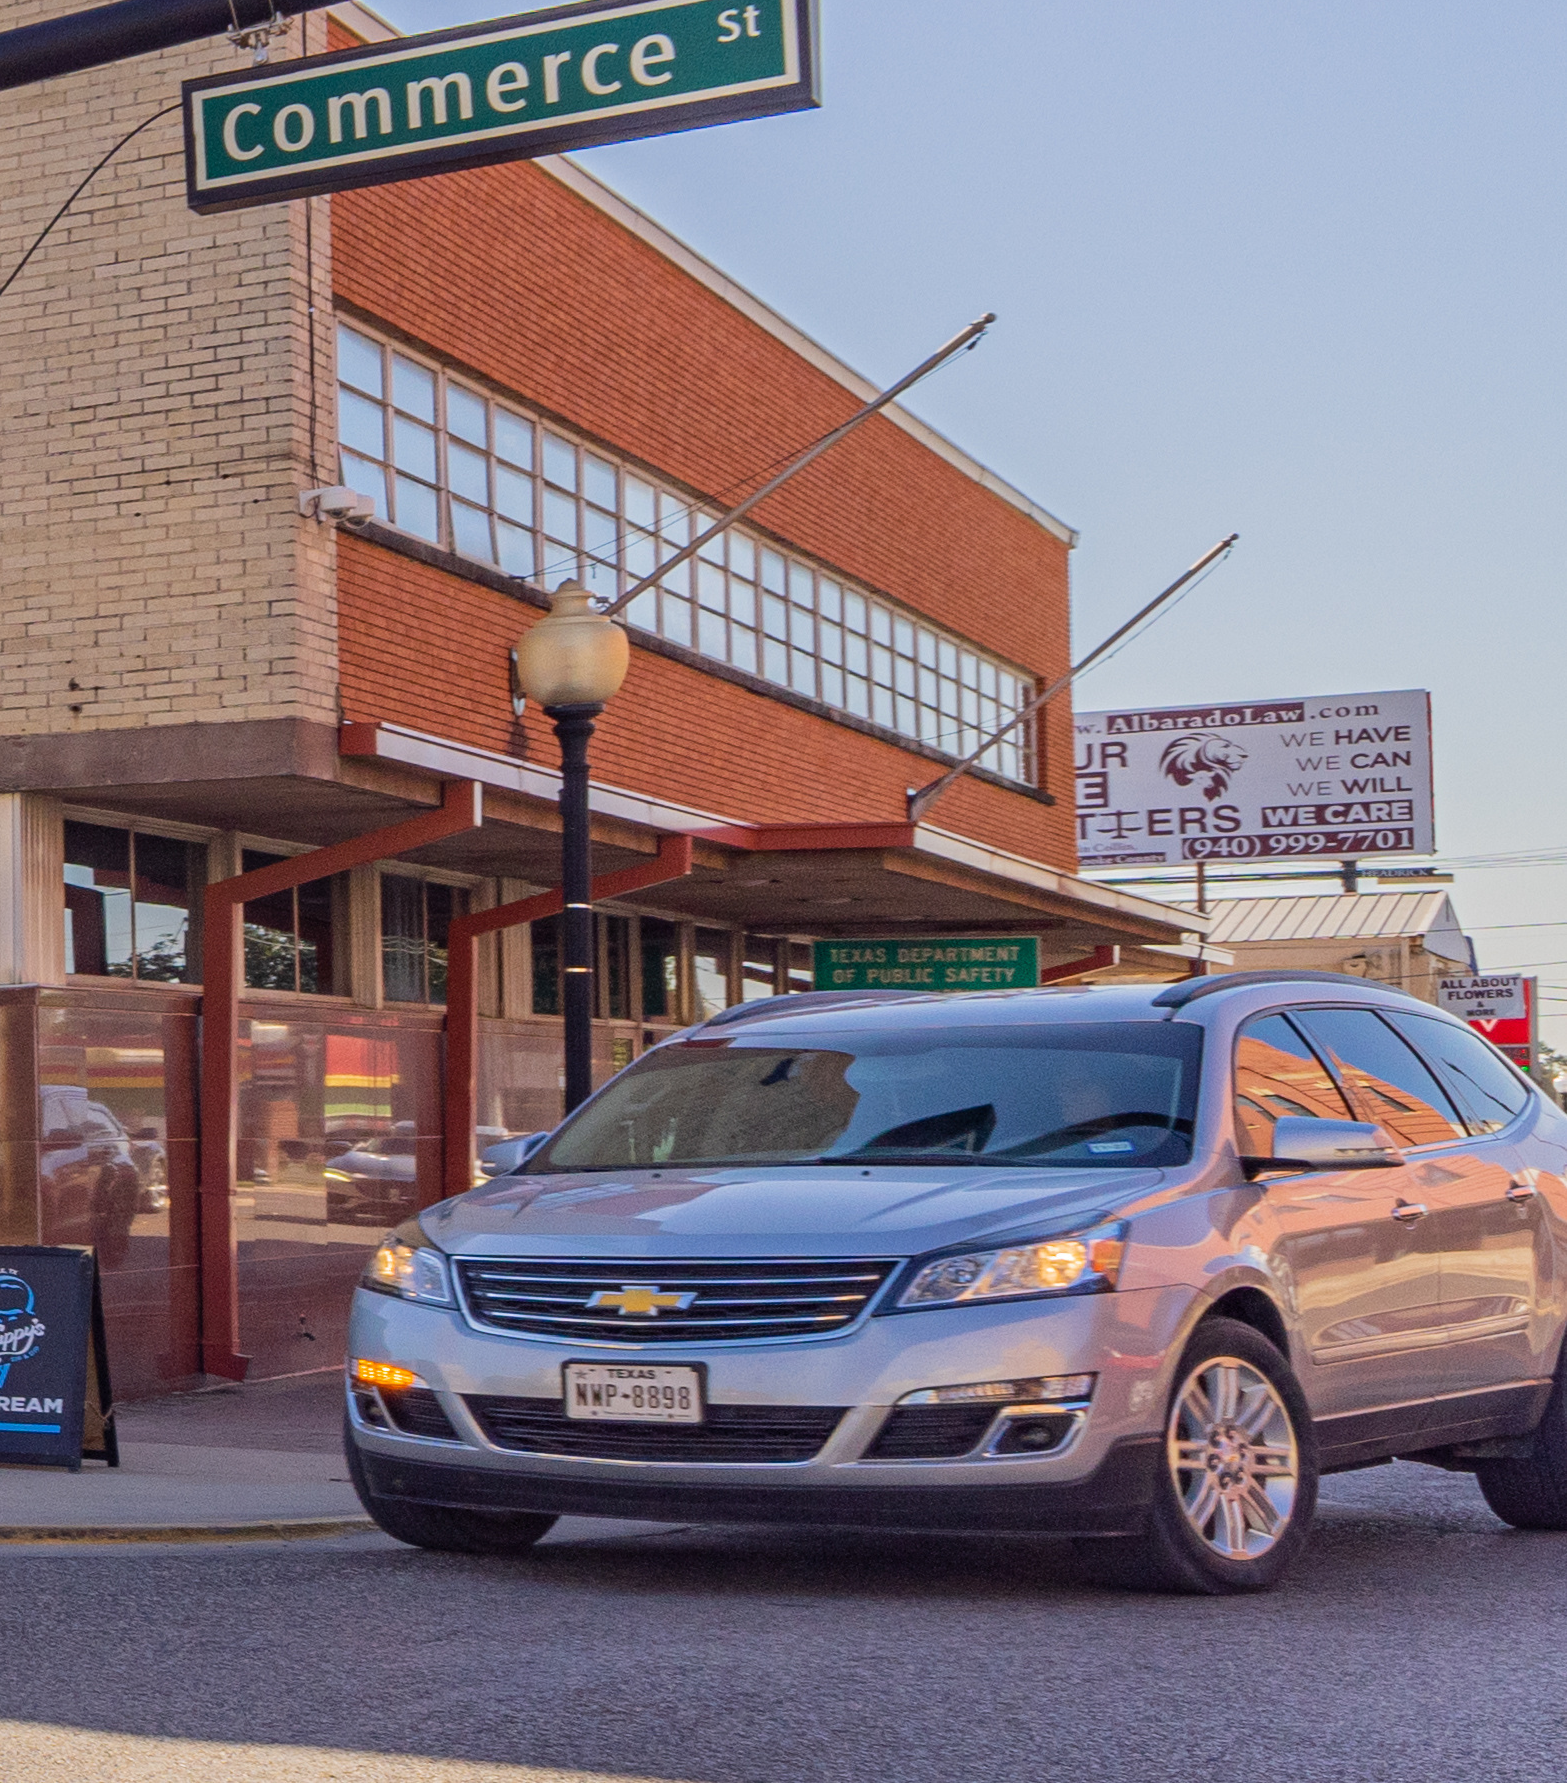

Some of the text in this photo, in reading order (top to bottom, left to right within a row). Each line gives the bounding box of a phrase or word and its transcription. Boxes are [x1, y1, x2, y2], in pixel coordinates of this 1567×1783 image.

[221, 4, 762, 161] Commerce St
[1280, 725, 1412, 748] WE HAVE
[1296, 750, 1412, 771] WE CAN
[1287, 776, 1413, 797] WE WILL
[1264, 801, 1411, 826] WE CARE
[1183, 829, 1412, 860] (940) 999-7701
[830, 946, 1020, 963] TEXAS DEPARTMENT
[833, 967, 1016, 984] OF PUBLIC SAFETY
[1440, 977, 1519, 990] ALL ABOUT
[1447, 989, 1514, 1001] FLOWERS
[1466, 1008, 1496, 1017] MORE
[607, 1368, 656, 1380] TEXAS
